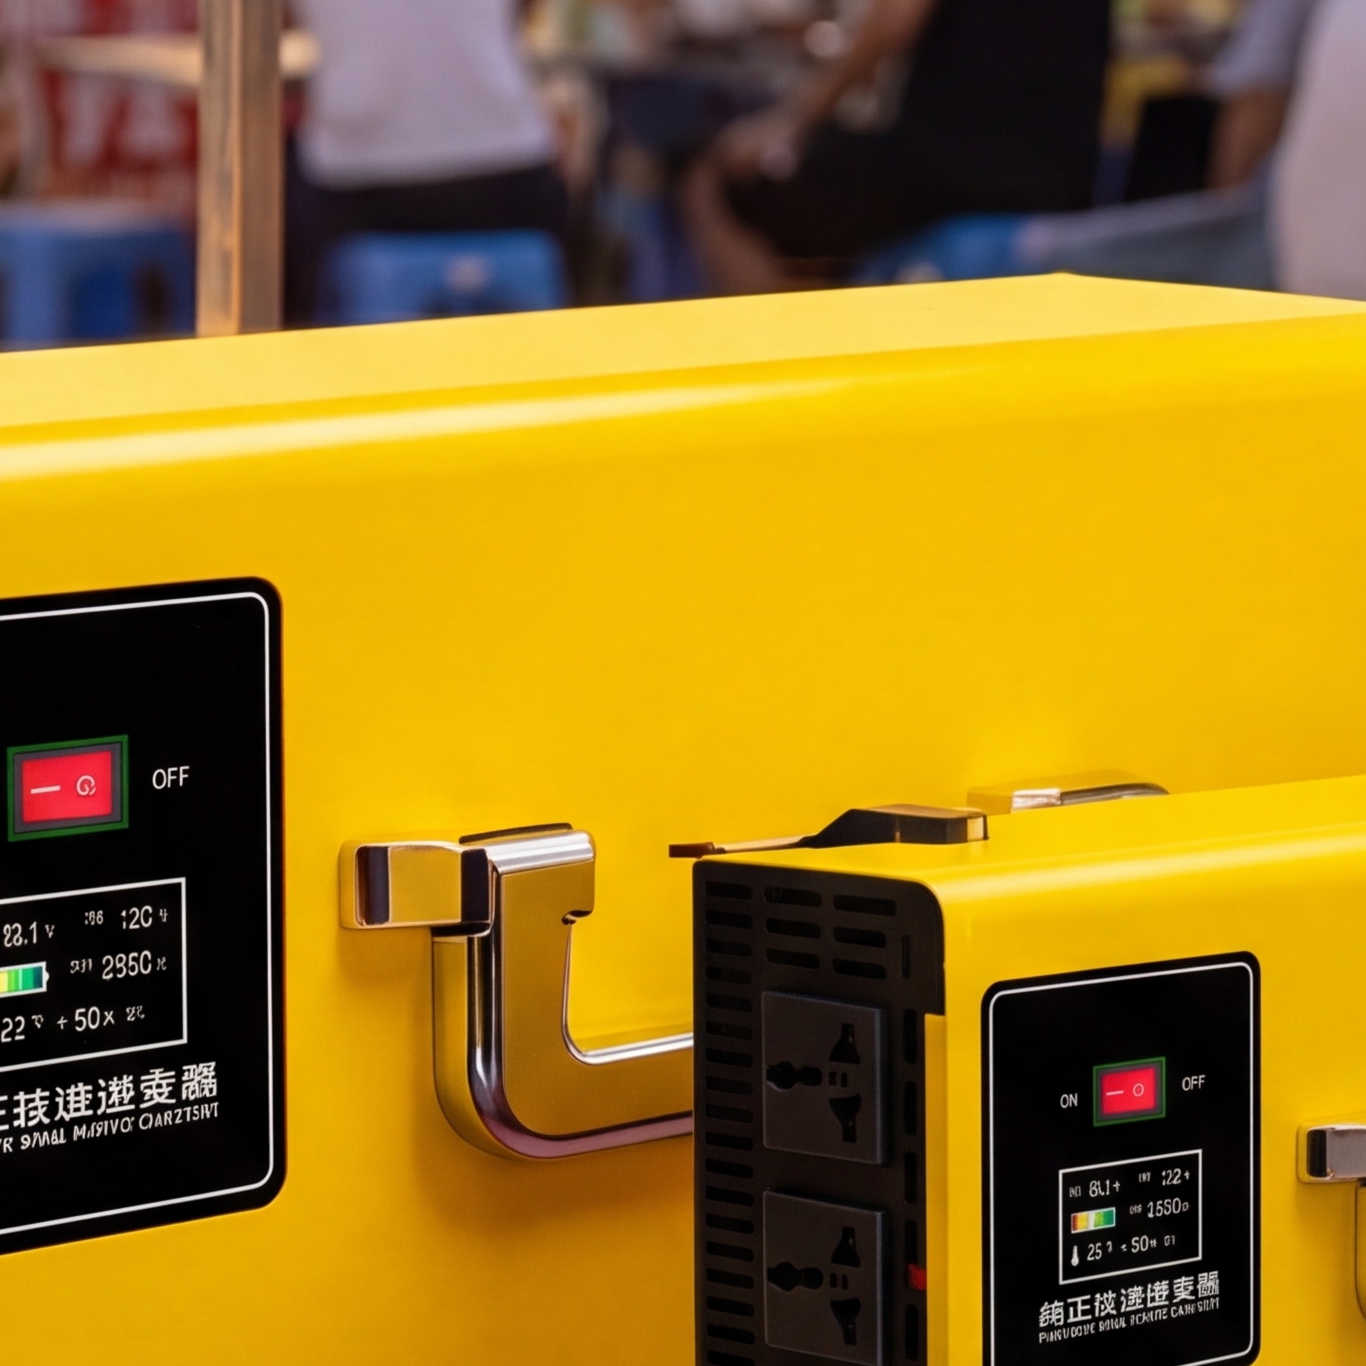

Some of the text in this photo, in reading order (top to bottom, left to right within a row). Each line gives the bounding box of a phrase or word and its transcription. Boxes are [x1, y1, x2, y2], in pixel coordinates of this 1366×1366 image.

[152, 765, 190, 790] OFF
[1181, 1074, 1206, 1092] OFF
[1060, 1093, 1078, 1109] ON
